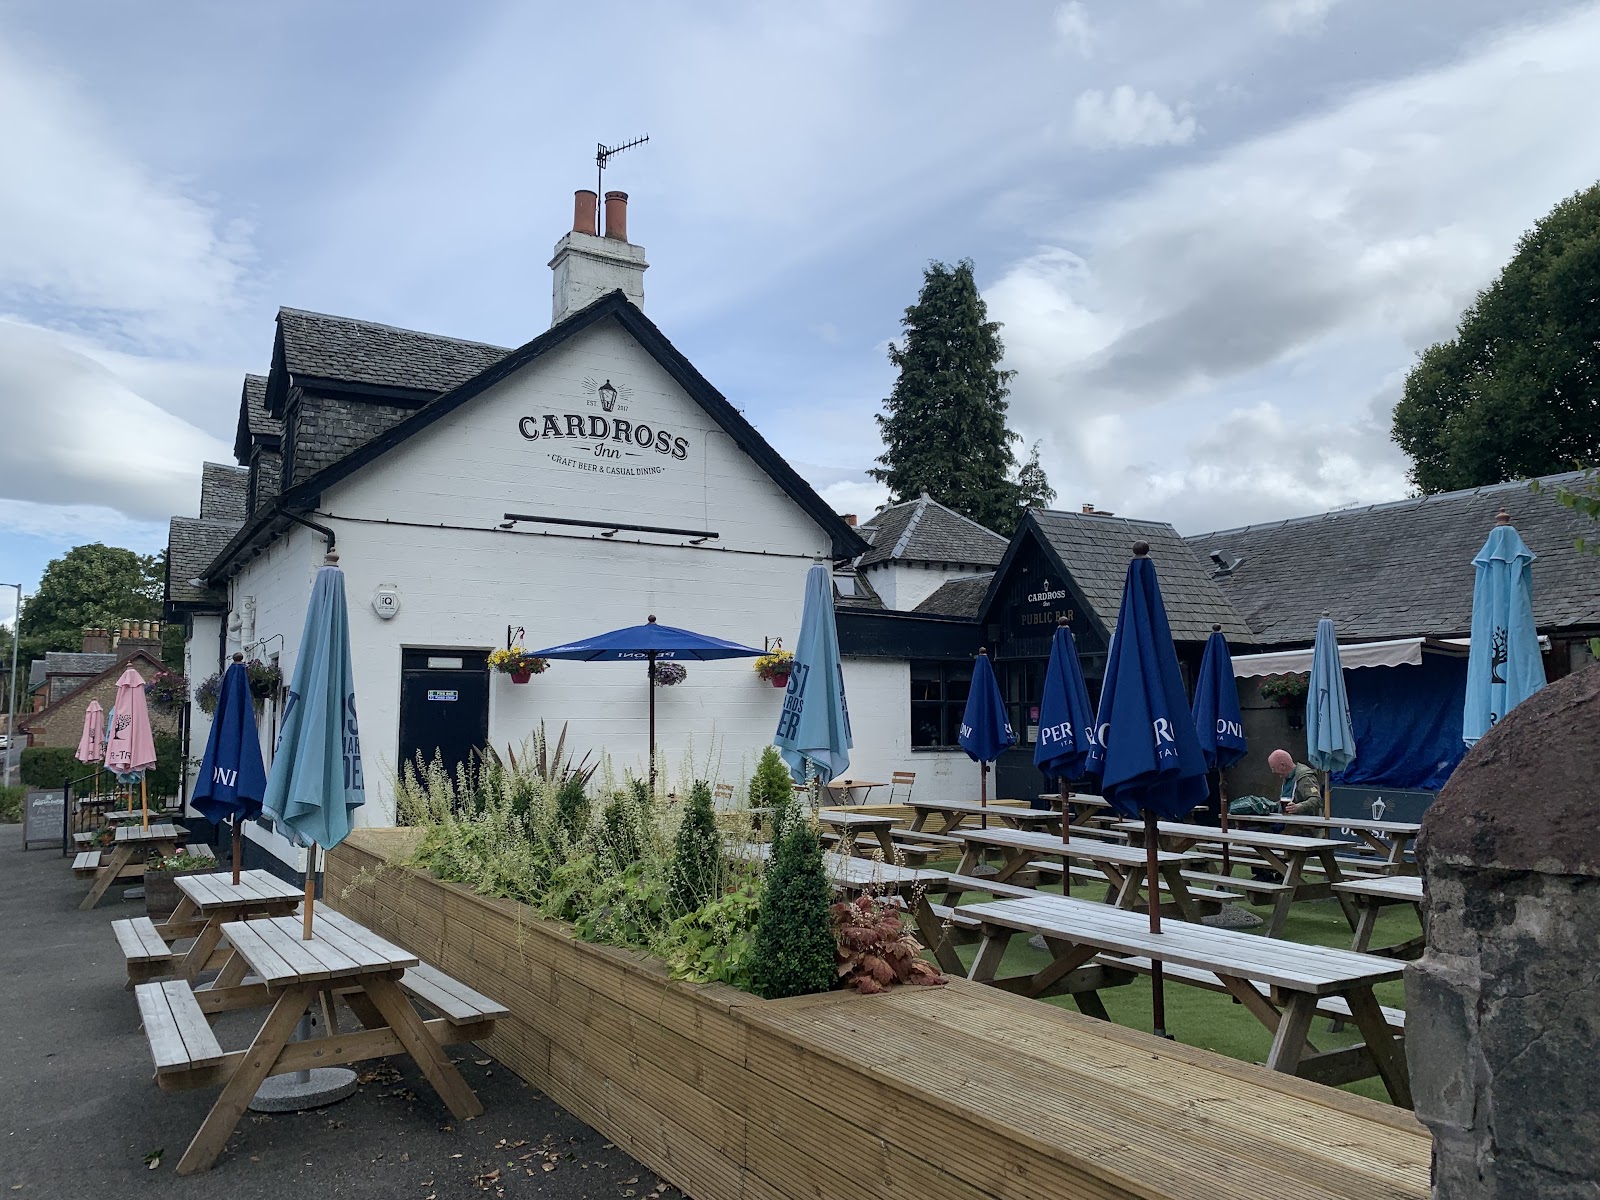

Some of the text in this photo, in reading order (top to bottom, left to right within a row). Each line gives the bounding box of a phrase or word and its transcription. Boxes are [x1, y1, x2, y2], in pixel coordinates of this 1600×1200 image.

[518, 414, 690, 461] CARDROSS
[594, 443, 622, 459] Inn
[551, 453, 577, 468] CRAFT
[578, 461, 598, 472] BEER
[606, 466, 635, 476] CASUAL
[636, 466, 661, 476] DINING
[1027, 590, 1066, 602] CARDROSS
[1021, 611, 1053, 626] PUBLIC
